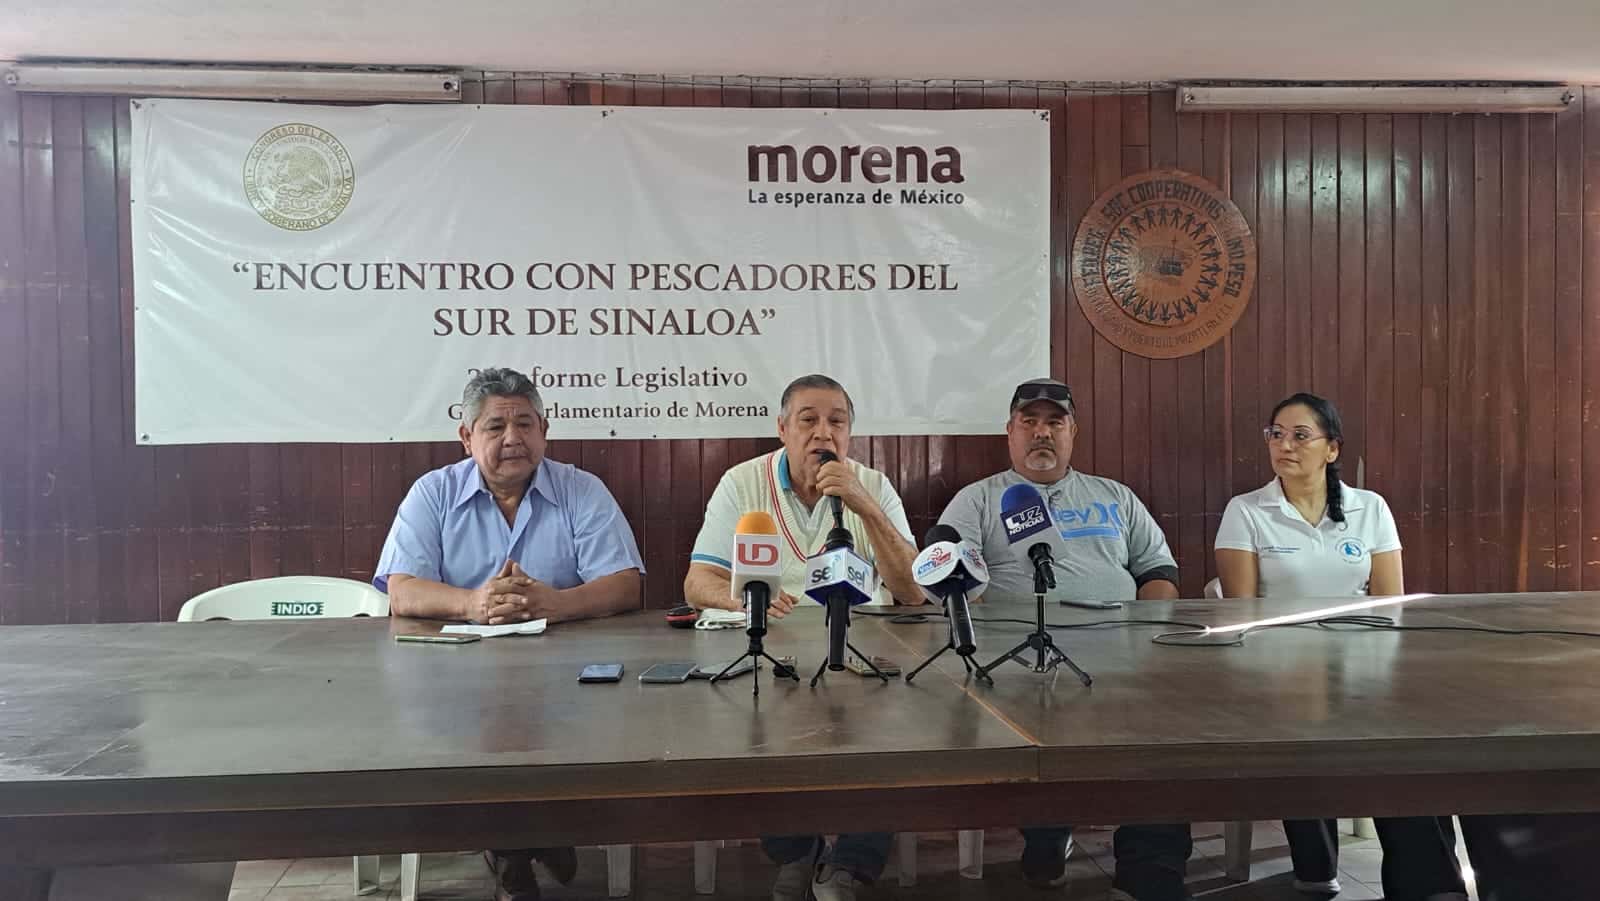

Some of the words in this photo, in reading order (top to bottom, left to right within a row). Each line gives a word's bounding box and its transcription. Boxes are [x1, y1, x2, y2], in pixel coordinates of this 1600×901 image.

[748, 145, 965, 184] morena
[748, 189, 768, 204] La
[774, 191, 866, 208] esperanza
[872, 189, 893, 204] de
[900, 189, 965, 205] México
[525, 262, 616, 291] CON
[628, 262, 876, 292] PESCADORES
[887, 263, 959, 291] DEL
[433, 308, 515, 336] SUR
[526, 308, 578, 336] DE
[531, 366, 607, 388] forme
[615, 366, 748, 392] Legislativo
[544, 401, 662, 420] rlamentario
[667, 401, 689, 418] de
[695, 402, 769, 418] Morena
[277, 603, 318, 614] INDIO
